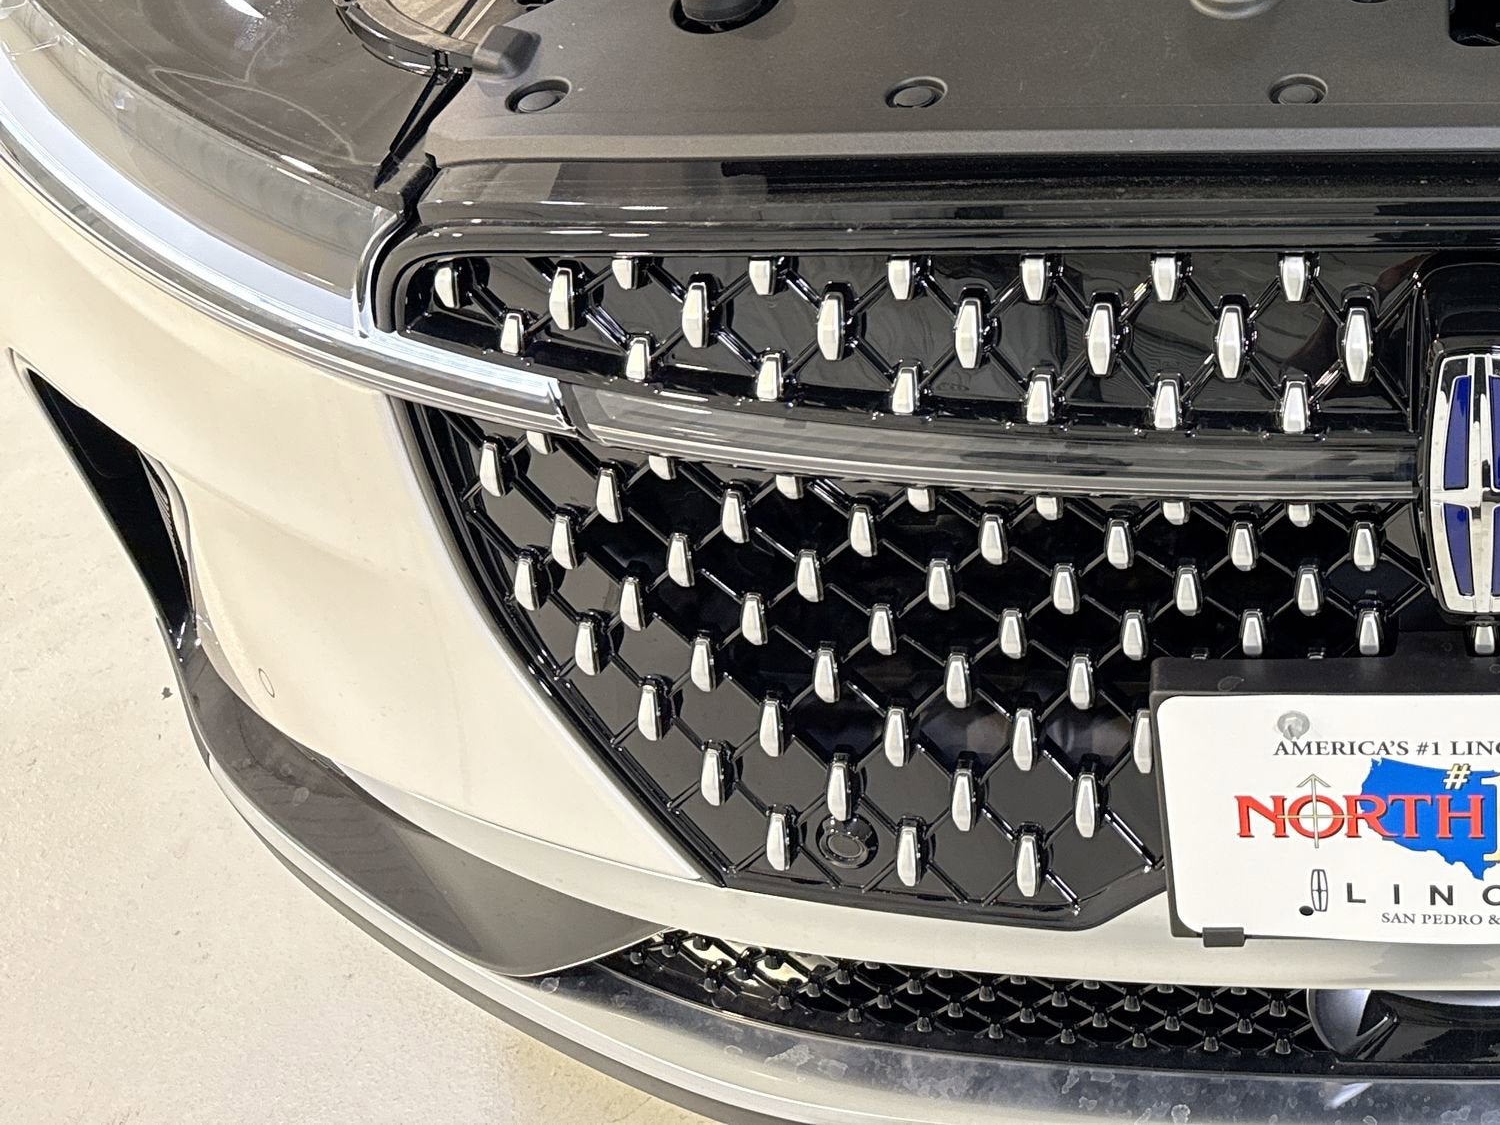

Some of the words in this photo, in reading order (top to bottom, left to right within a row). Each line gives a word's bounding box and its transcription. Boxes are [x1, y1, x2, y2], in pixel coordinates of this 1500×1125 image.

[1274, 741, 1408, 755] AMERICA'S
[1416, 741, 1441, 756] #1
[1235, 794, 1486, 838] NORTH
[1383, 914, 1414, 923] SAN
[1423, 915, 1482, 924] PEDRO
[1489, 916, 1499, 924] &
